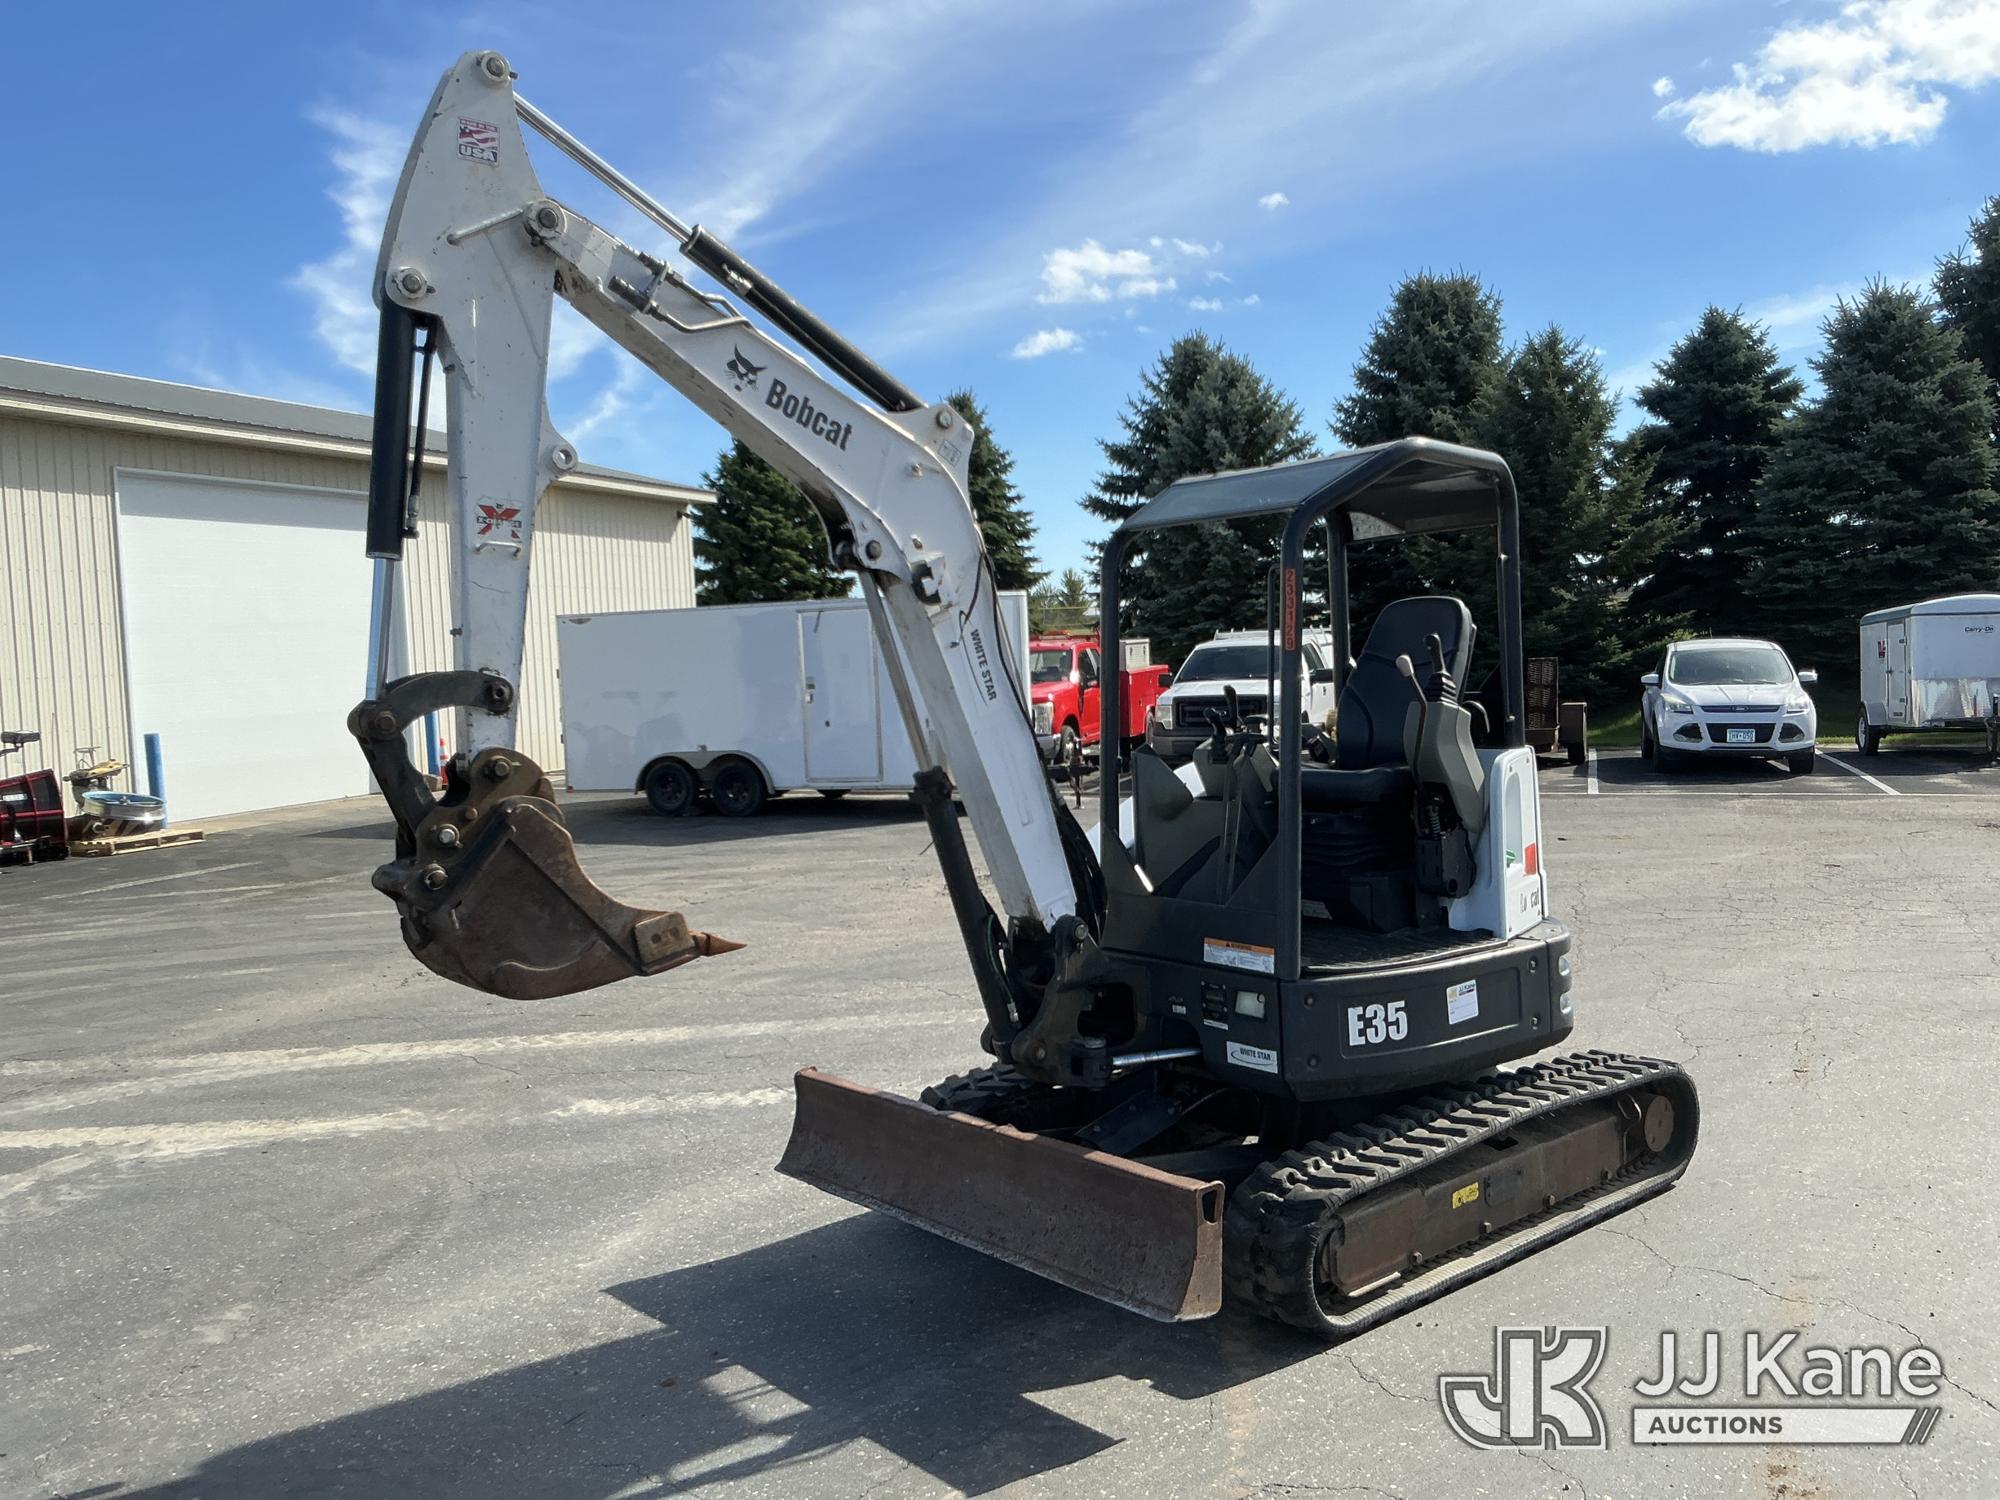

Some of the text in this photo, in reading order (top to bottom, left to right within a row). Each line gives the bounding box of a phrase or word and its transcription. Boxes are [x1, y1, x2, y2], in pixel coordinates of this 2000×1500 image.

[460, 145, 495, 161] USA
[765, 378, 852, 451] Bobcat
[1285, 570, 1295, 650] 233129
[970, 629, 998, 701] WHITE STAR
[1348, 1000, 1408, 1046] E35
[1240, 1048, 1271, 1061] WHITE STAR
